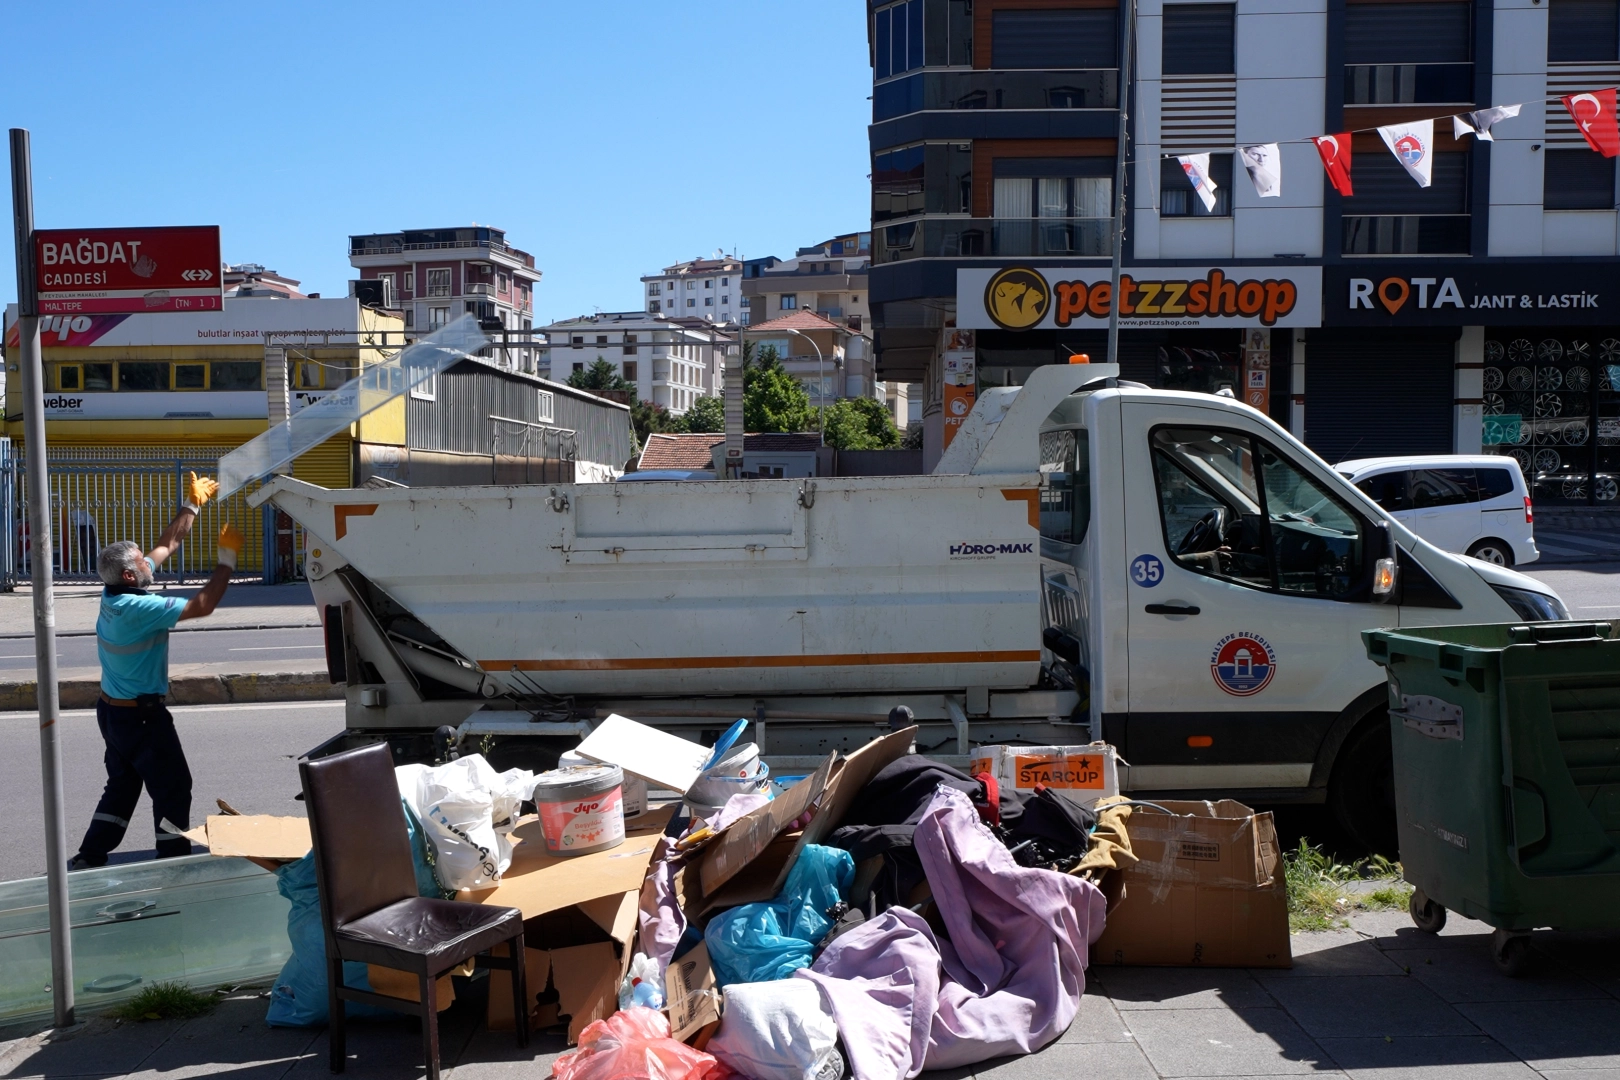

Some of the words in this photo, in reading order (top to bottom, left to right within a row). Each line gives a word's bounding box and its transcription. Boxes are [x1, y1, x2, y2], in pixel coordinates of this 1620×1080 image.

[42, 238, 142, 265] BAĞDAT
[44, 270, 107, 286] CADDESİ
[1055, 269, 1297, 325] petzzshop
[1349, 277, 1465, 316] ROTA
[1469, 295, 1516, 309] JANT
[1519, 295, 1533, 309] &
[1537, 290, 1599, 308] LASTİK
[44, 302, 82, 311] MALTEPE
[197, 329, 231, 338] bulutlar
[232, 329, 259, 340] inşaat
[1134, 560, 1160, 582] 35
[1210, 632, 1236, 664] MALTEPE
[1020, 771, 1099, 784] STARCUP
[573, 802, 599, 814] dyo
